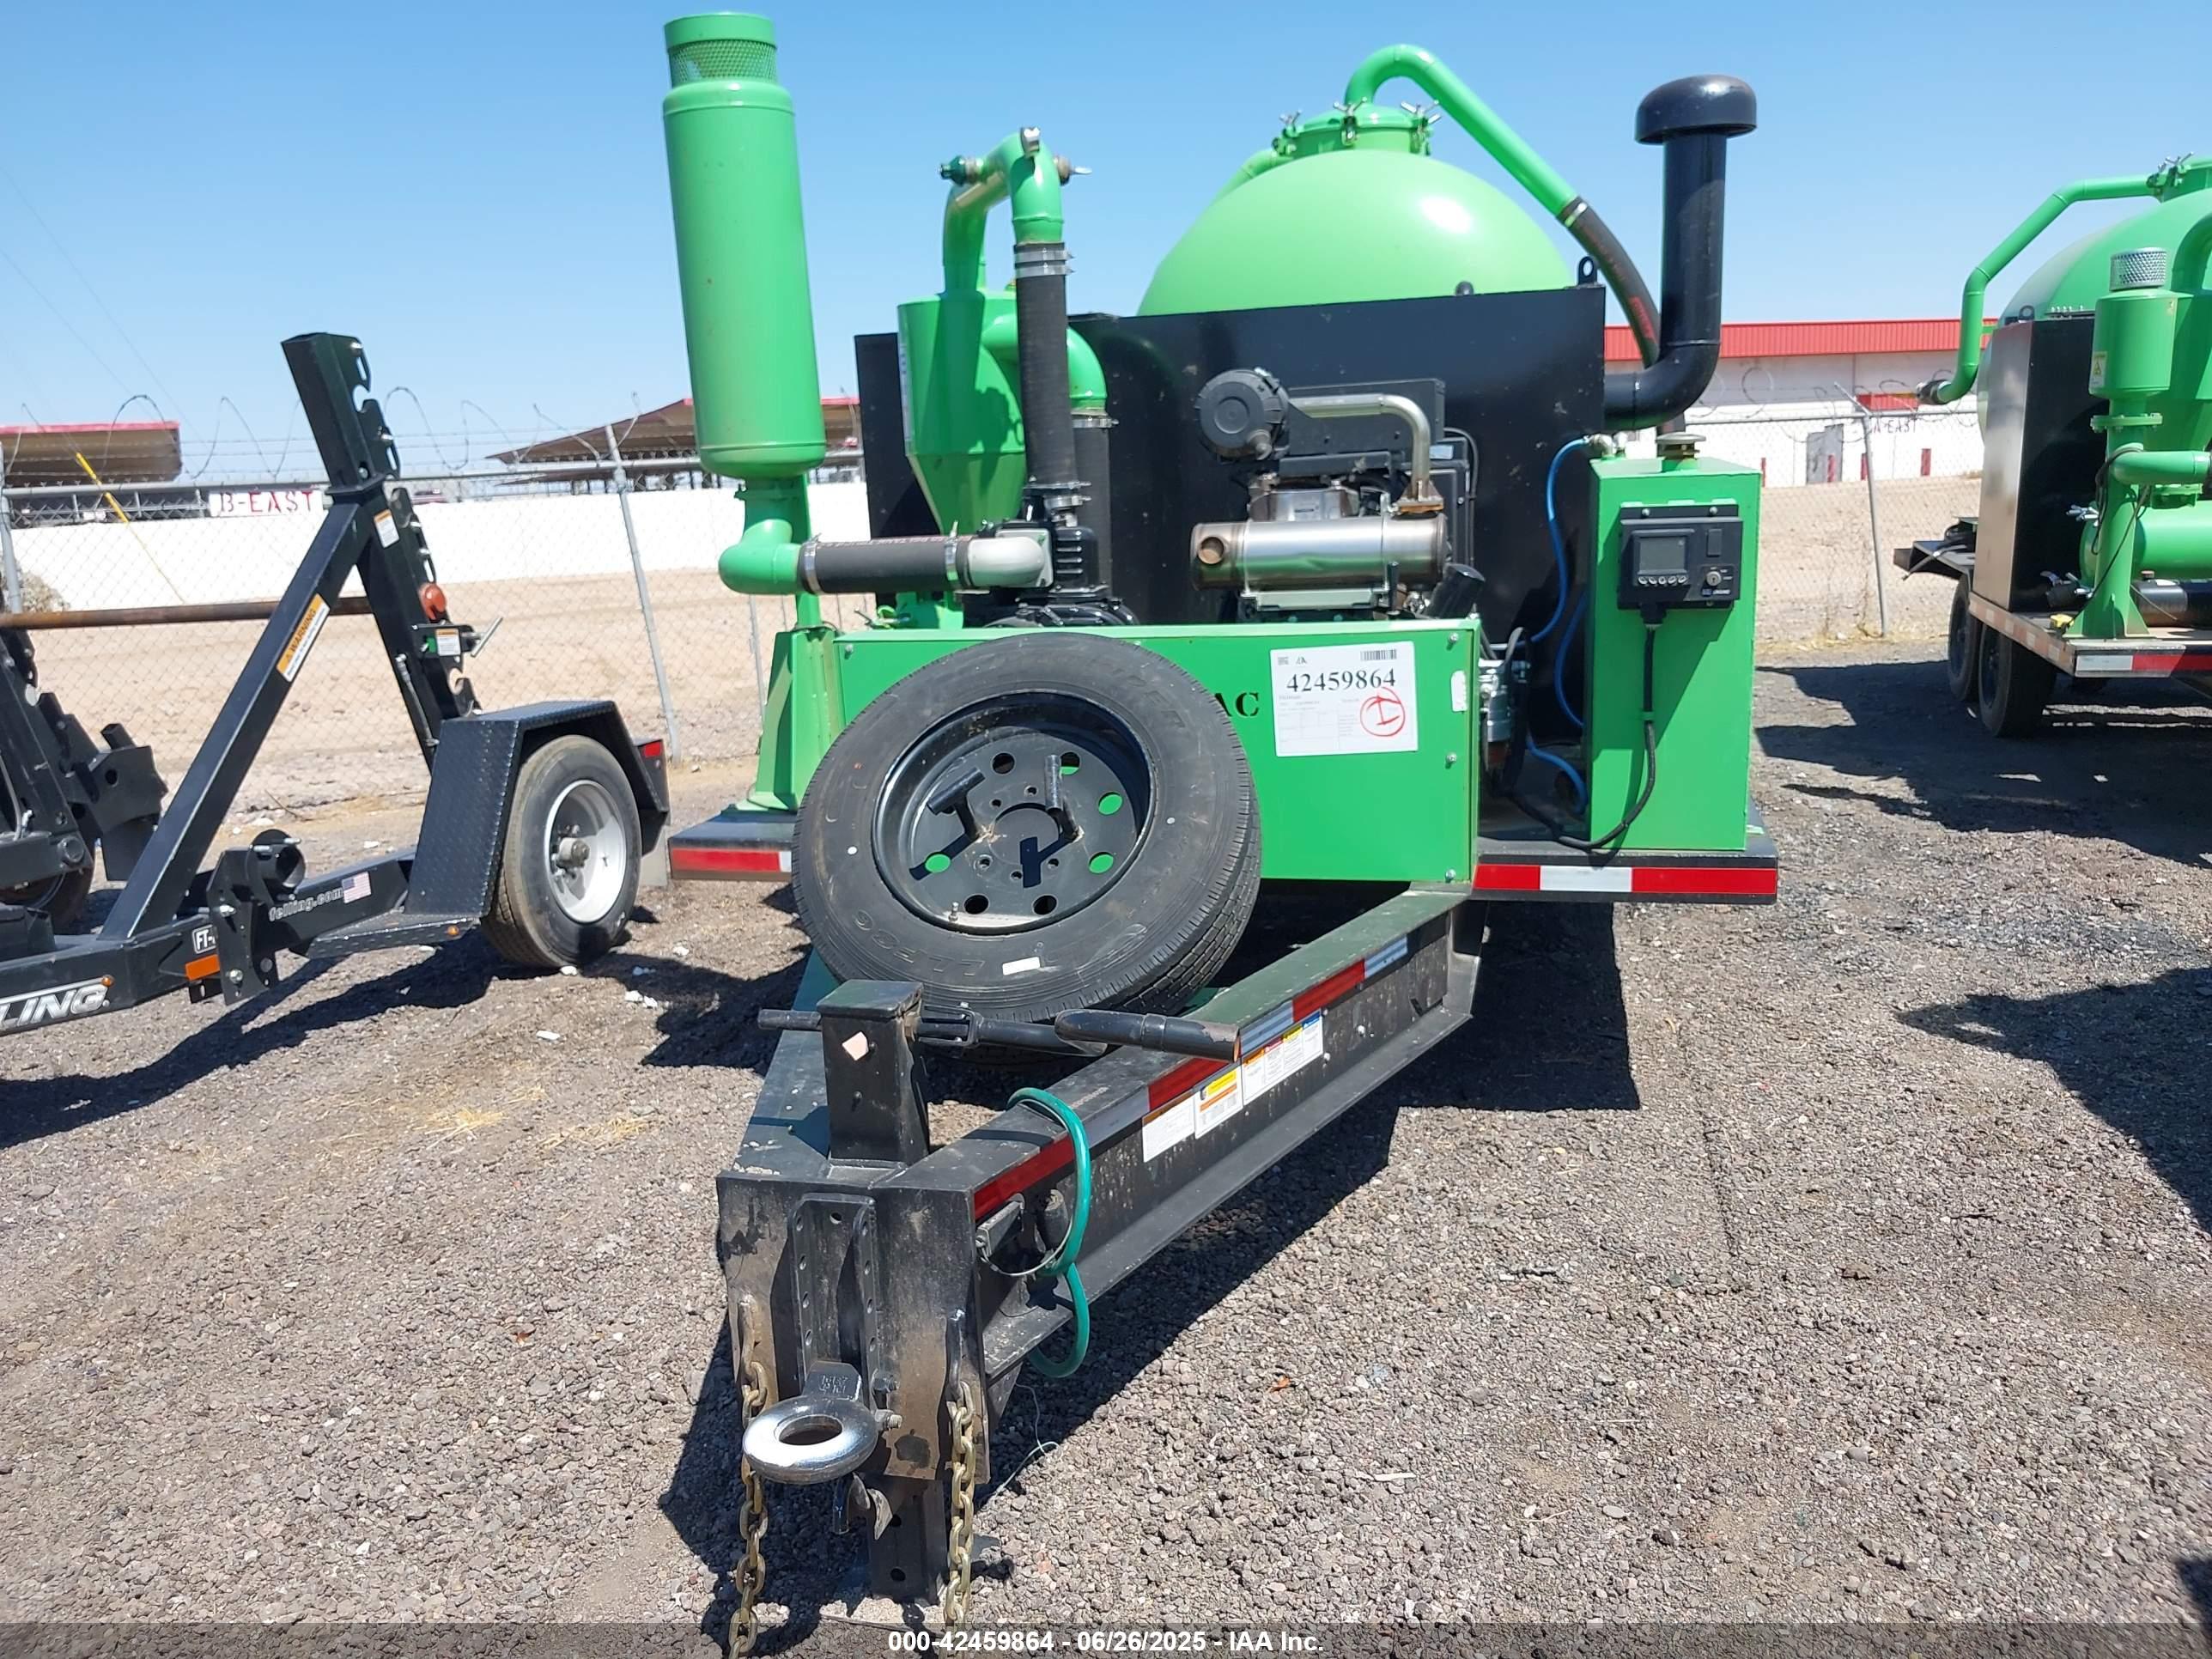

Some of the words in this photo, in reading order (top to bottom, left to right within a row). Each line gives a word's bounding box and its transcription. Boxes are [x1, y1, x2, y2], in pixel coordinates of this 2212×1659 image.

[220, 490, 313, 513] B-EAST
[1286, 668, 1395, 692] 42459864
[269, 887, 344, 922] felling.com
